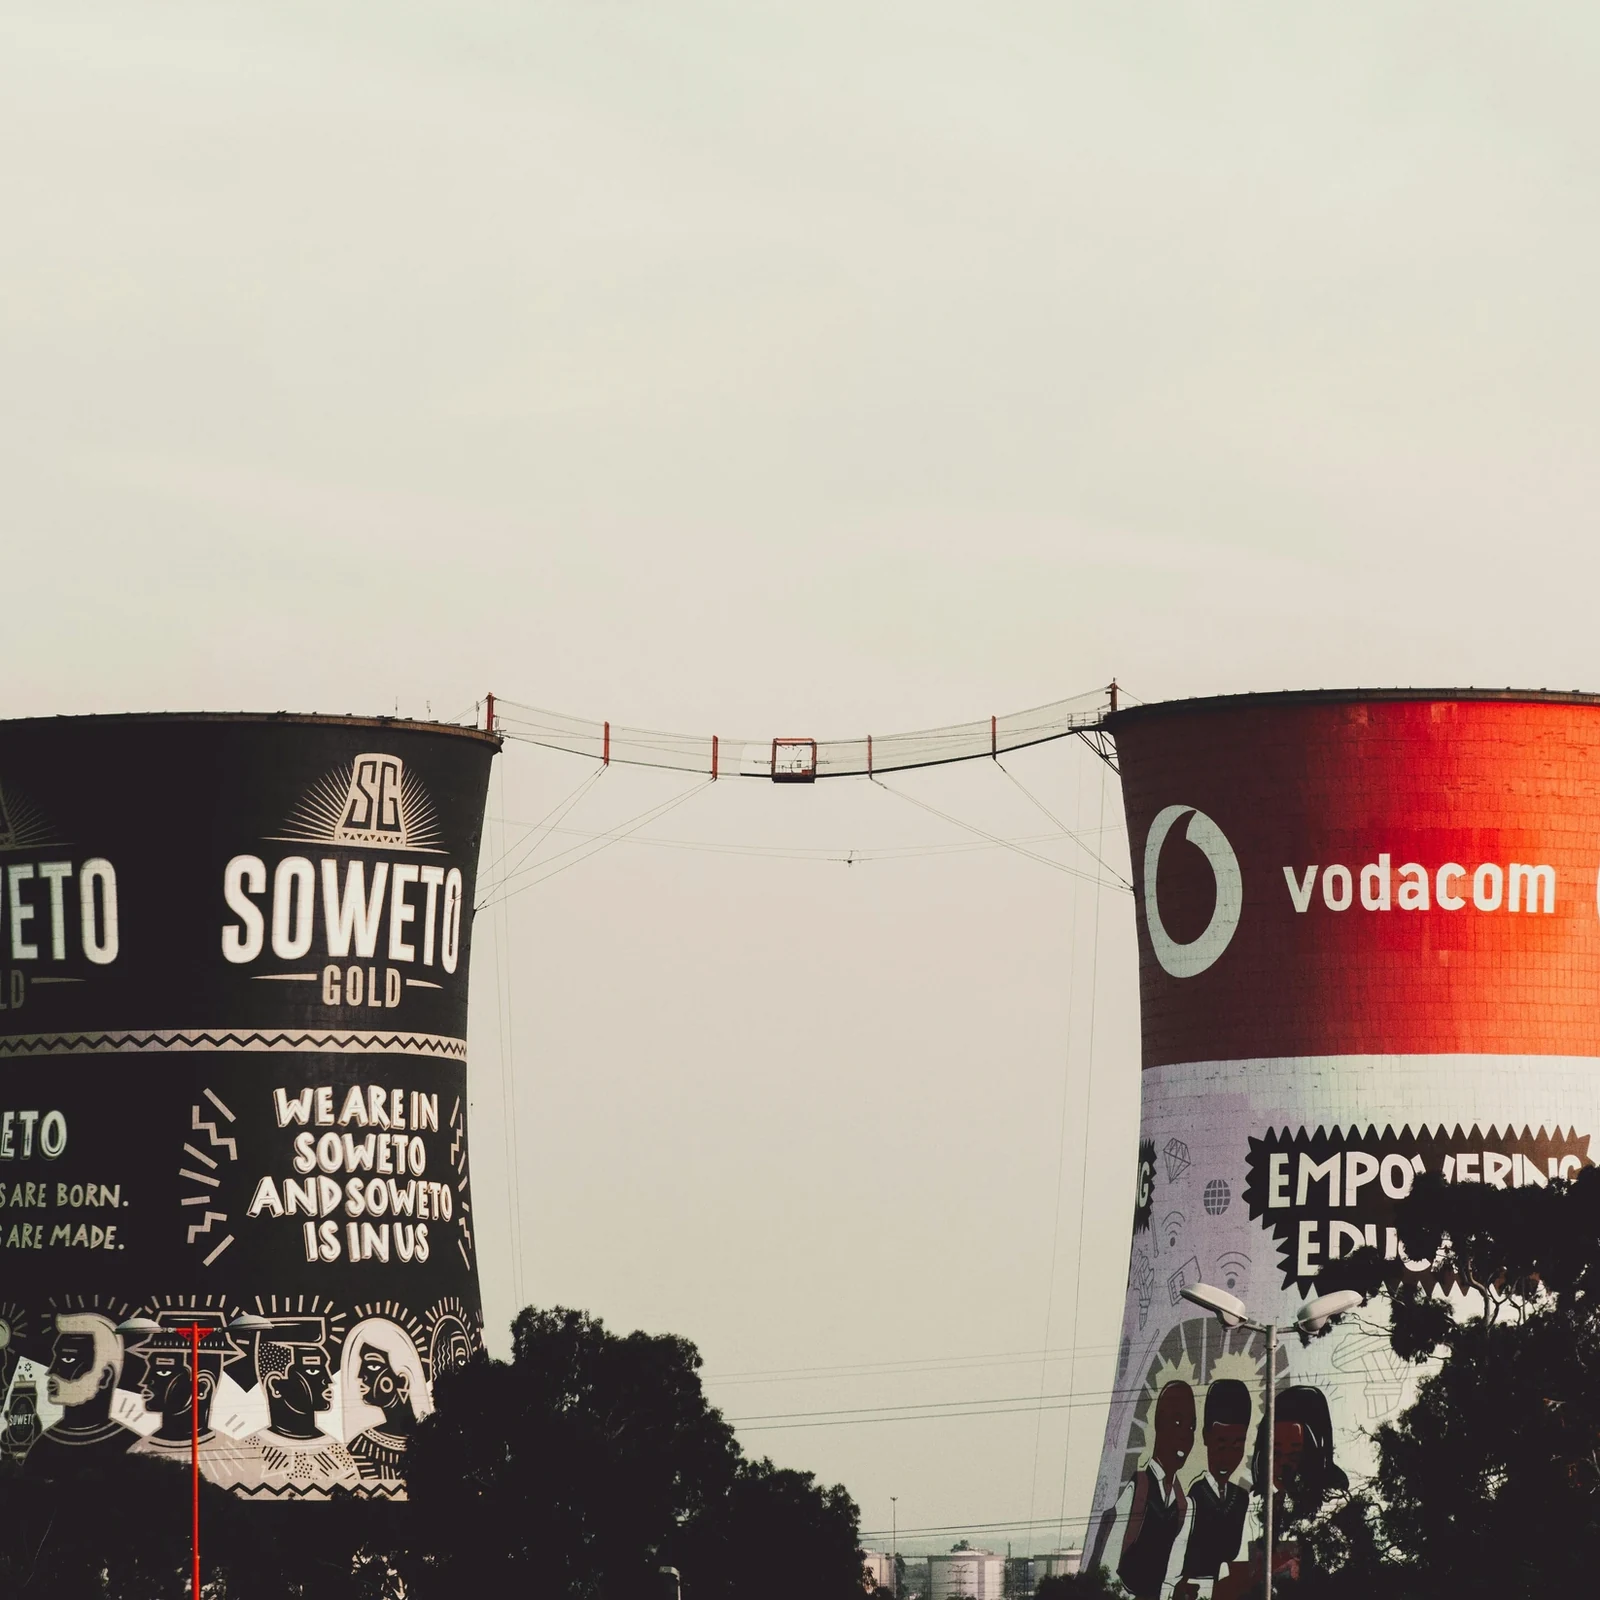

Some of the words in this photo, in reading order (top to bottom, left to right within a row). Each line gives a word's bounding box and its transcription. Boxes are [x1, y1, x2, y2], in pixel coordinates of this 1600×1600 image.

[1282, 852, 1556, 914] vodacom
[0, 857, 119, 965] ETO
[221, 854, 463, 974] SOWETO
[321, 964, 402, 1008] GOLD
[272, 1086, 335, 1128] WE
[337, 1084, 406, 1131] ARE
[410, 1090, 439, 1133] IN
[292, 1131, 427, 1177] SOWETO
[9, 1181, 47, 1208] ARE
[56, 1182, 130, 1208] BORN.
[246, 1174, 343, 1219] AND
[345, 1177, 453, 1222] SOWETO
[6, 1222, 44, 1250] ARE
[49, 1223, 125, 1250] MADE.
[303, 1219, 342, 1263] IS
[346, 1221, 390, 1264] IN
[392, 1221, 430, 1264] US
